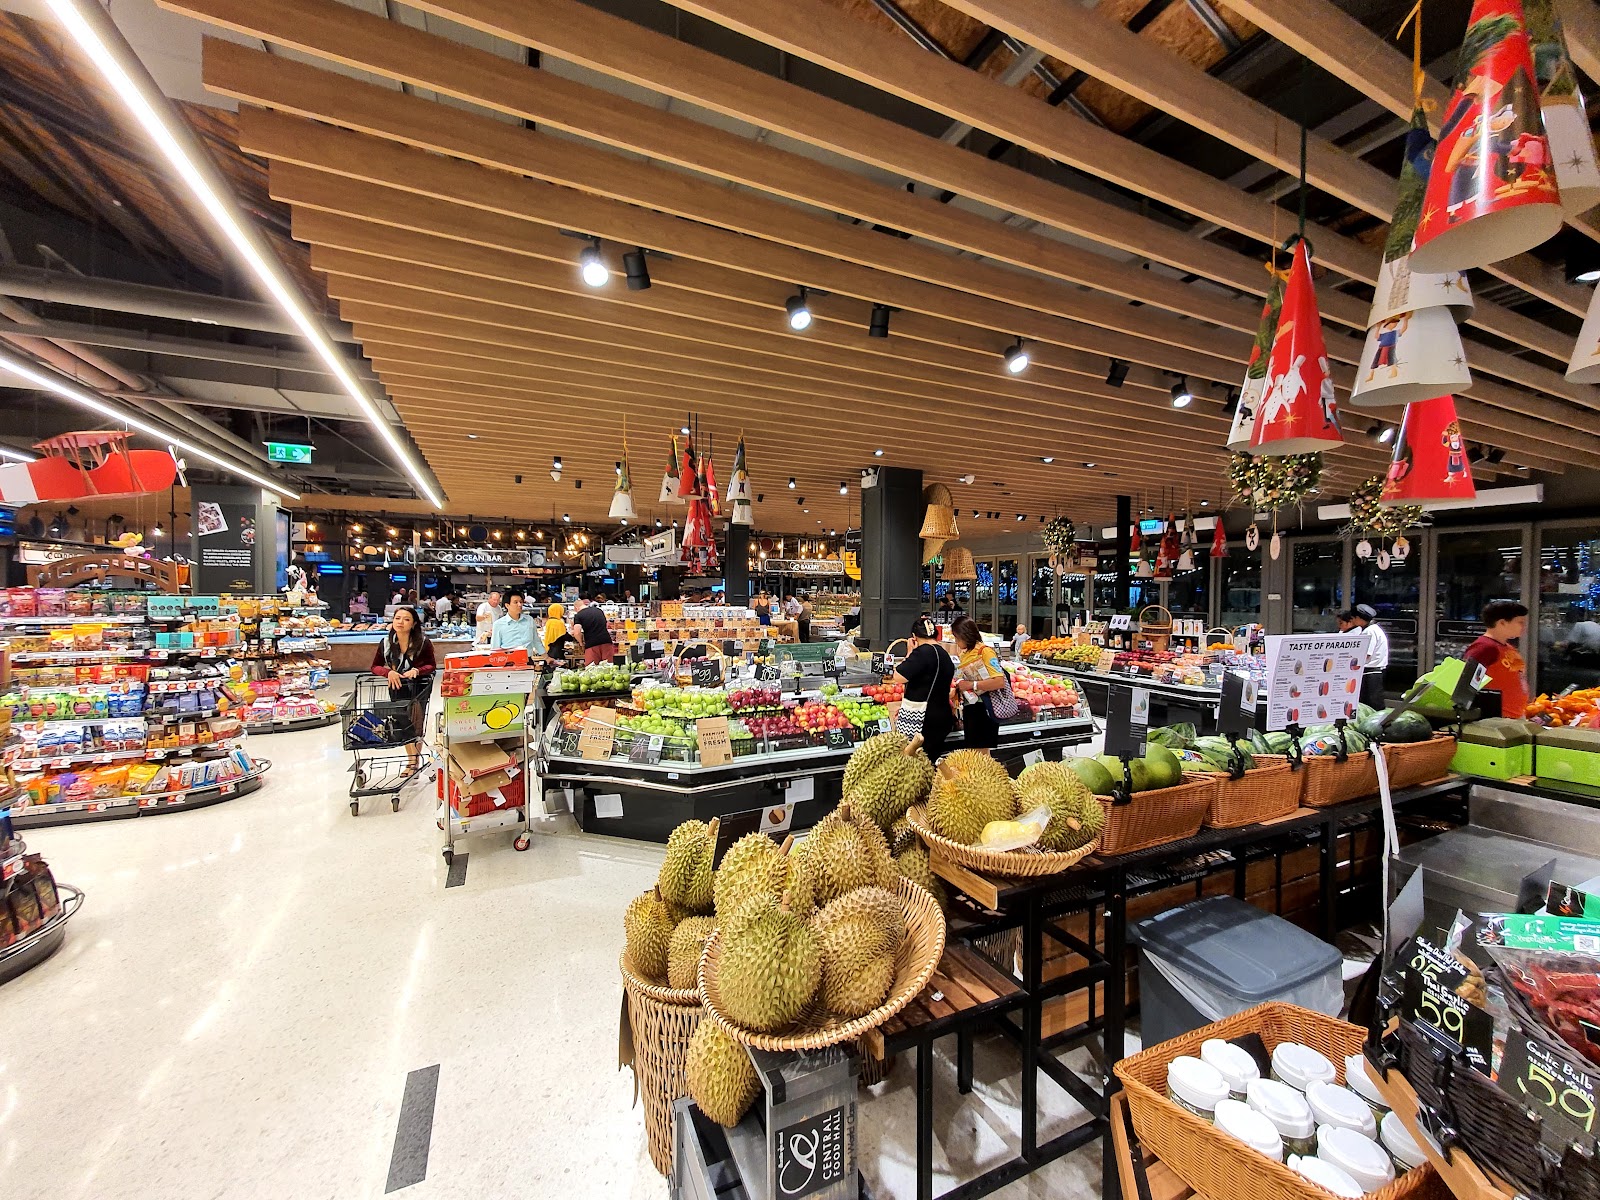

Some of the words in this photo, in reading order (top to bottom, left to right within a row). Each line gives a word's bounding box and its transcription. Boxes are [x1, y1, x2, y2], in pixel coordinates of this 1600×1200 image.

[455, 554, 485, 562] OCEAN
[486, 554, 503, 562] BAR
[1289, 643, 1313, 651] TASTE
[1314, 642, 1324, 650] OF
[1325, 641, 1361, 649] PARADISE
[829, 733, 845, 745] 35
[1440, 985, 1470, 1012] Garlic
[1414, 990, 1464, 1044] 59
[1525, 1040, 1560, 1069] Garlic
[1562, 1061, 1594, 1090] Bulb
[1516, 1062, 1596, 1133] 59
[833, 1111, 841, 1141] HALL
[823, 1115, 832, 1180] CENTRAL
[833, 1144, 841, 1177] FOOD
